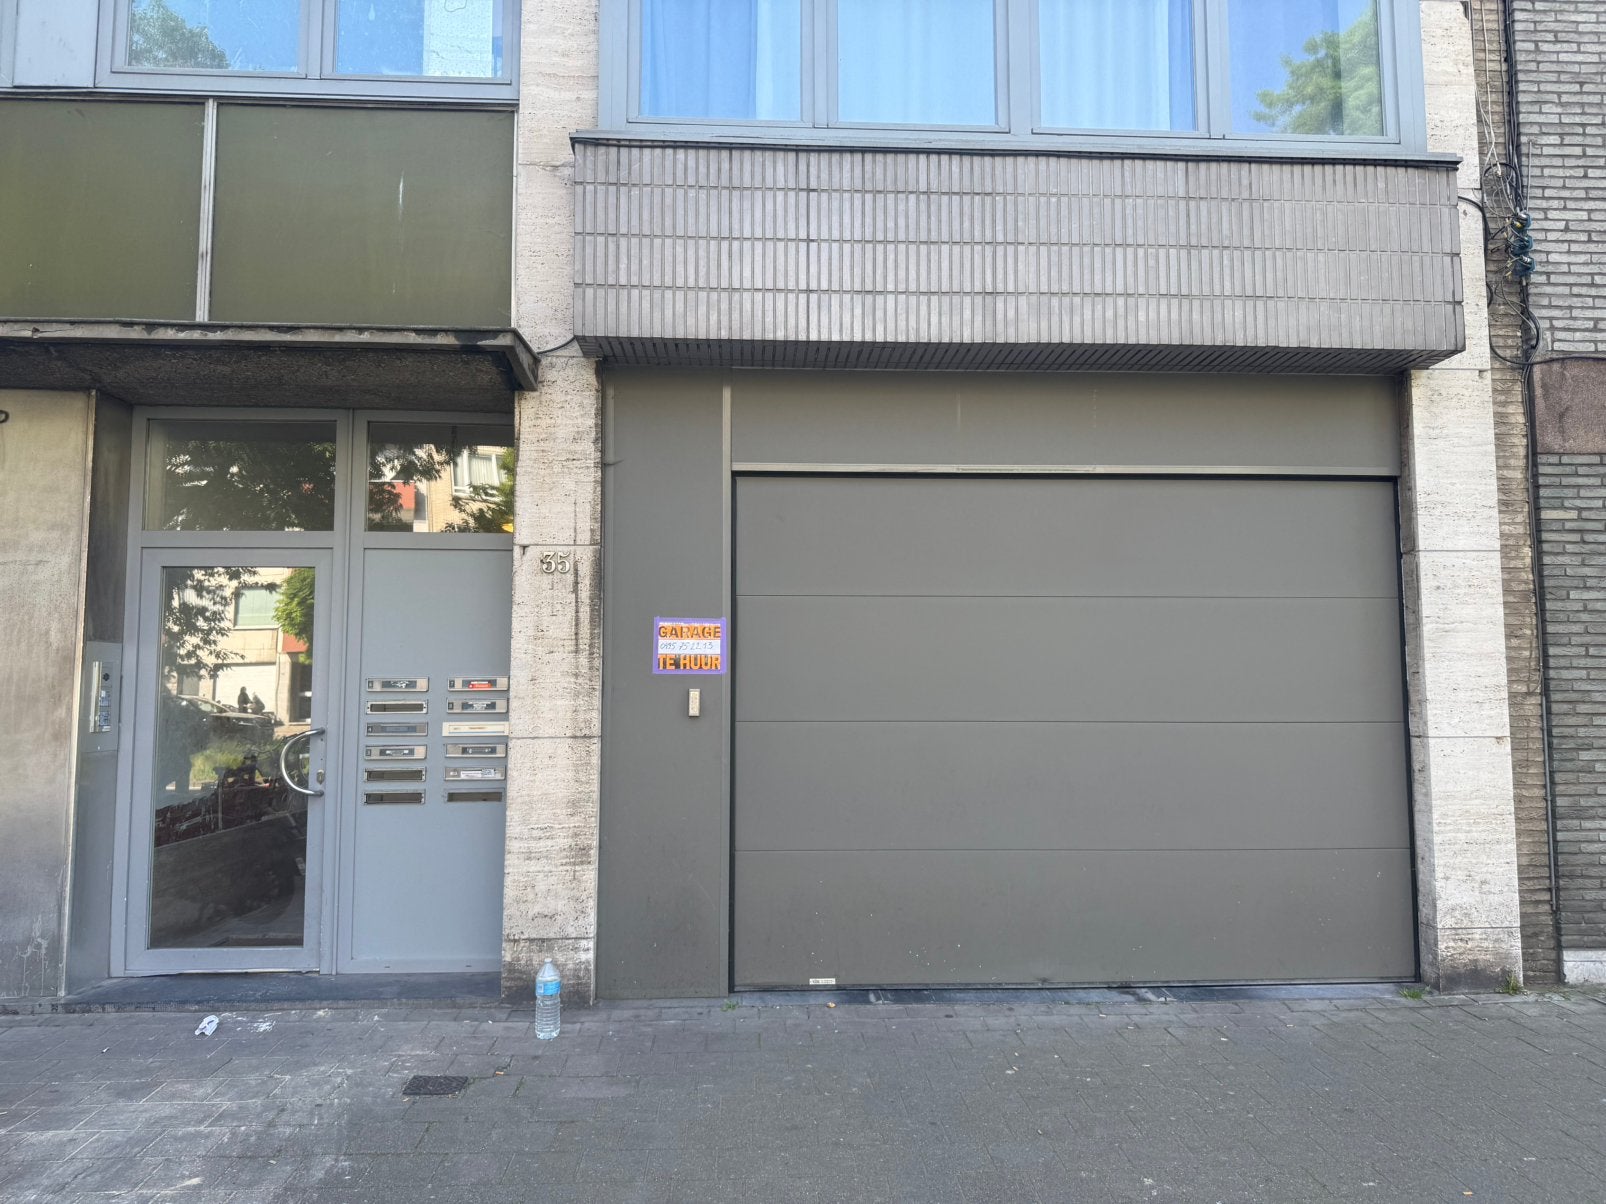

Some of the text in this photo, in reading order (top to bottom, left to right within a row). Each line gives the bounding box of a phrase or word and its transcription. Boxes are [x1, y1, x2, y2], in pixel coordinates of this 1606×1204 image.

[541, 551, 570, 573] 35
[658, 625, 721, 639] GARAGE
[658, 654, 721, 670] TE HUUR
